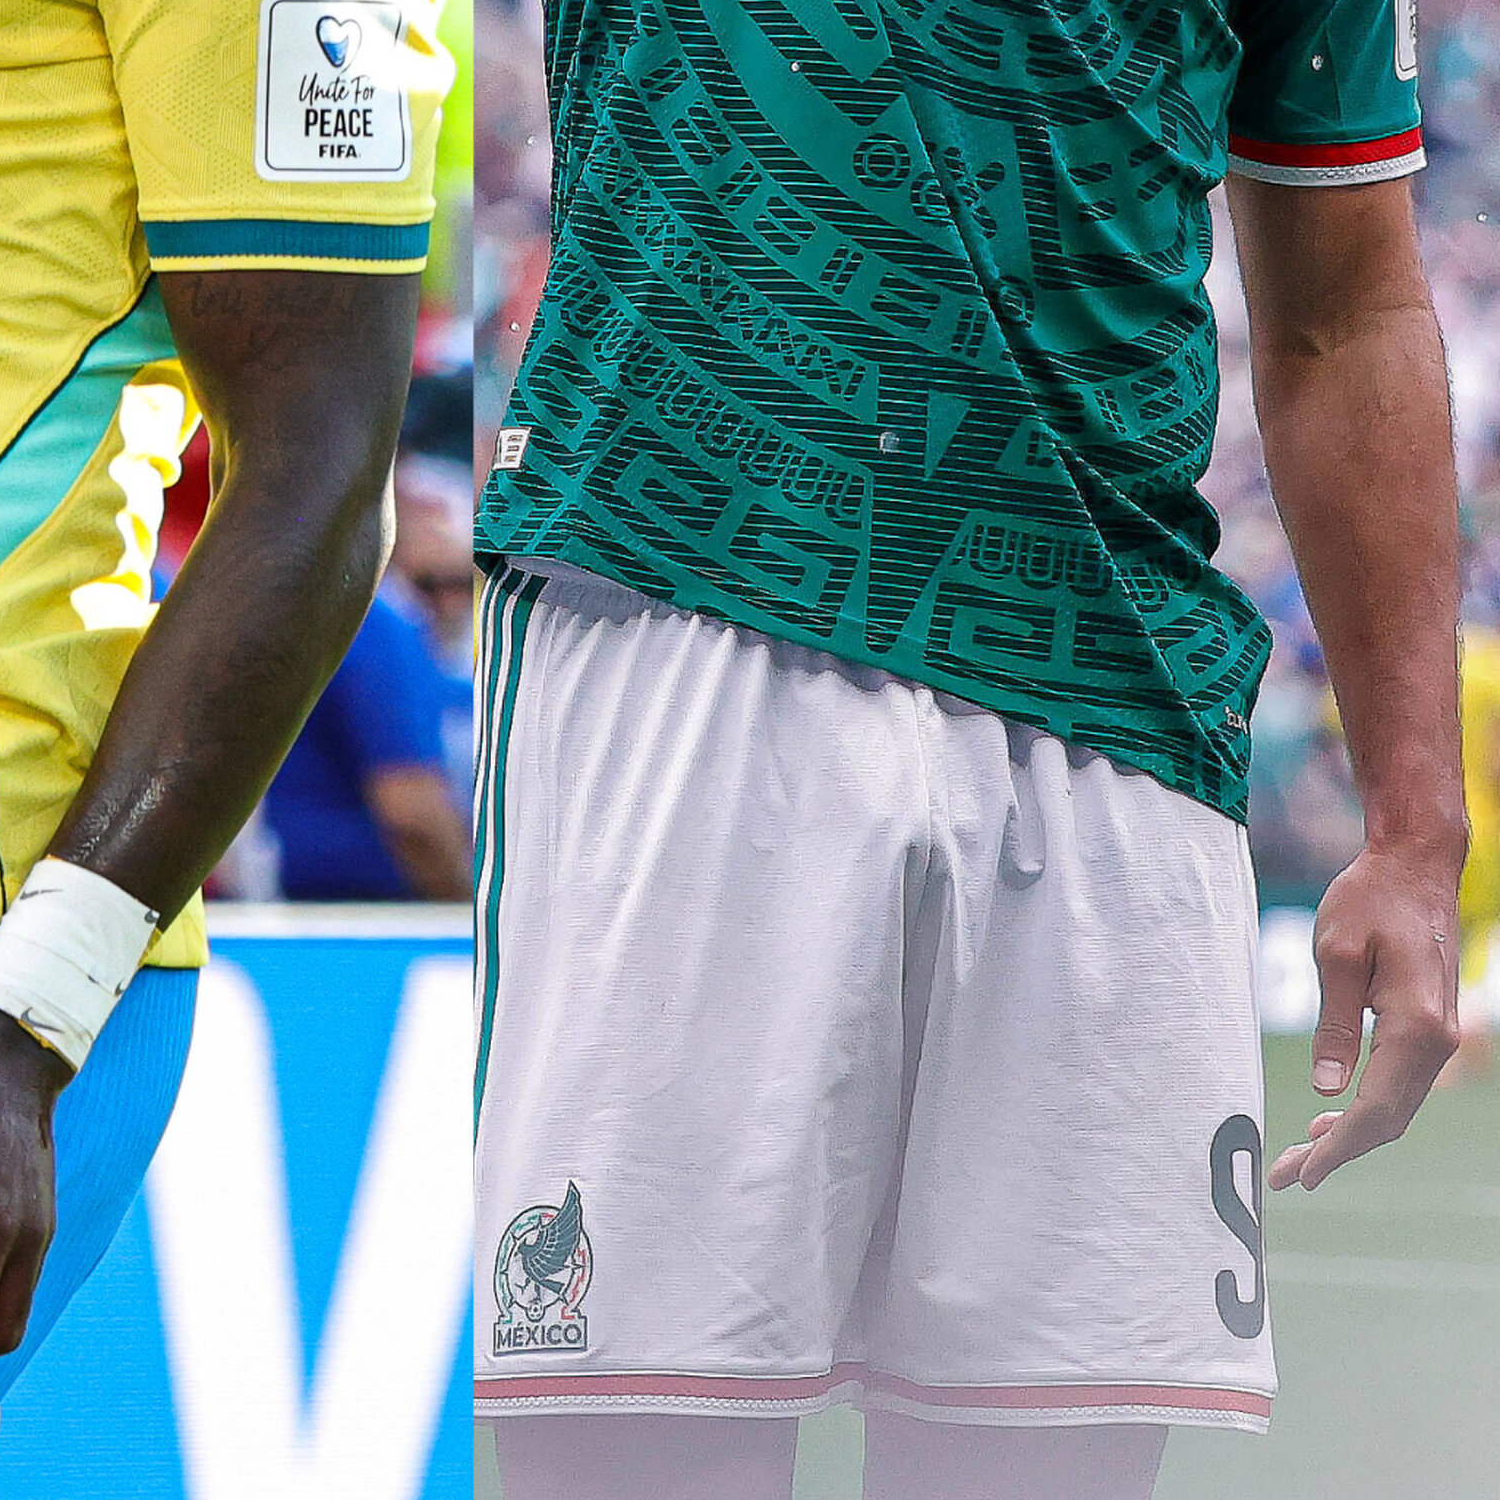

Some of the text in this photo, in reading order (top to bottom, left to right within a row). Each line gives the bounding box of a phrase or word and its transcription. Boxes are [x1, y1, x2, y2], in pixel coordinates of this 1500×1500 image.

[300, 72, 377, 107] Unite For
[304, 108, 374, 138] PEACE
[319, 144, 358, 159] FIFA
[498, 1321, 581, 1349] MÉXICO
